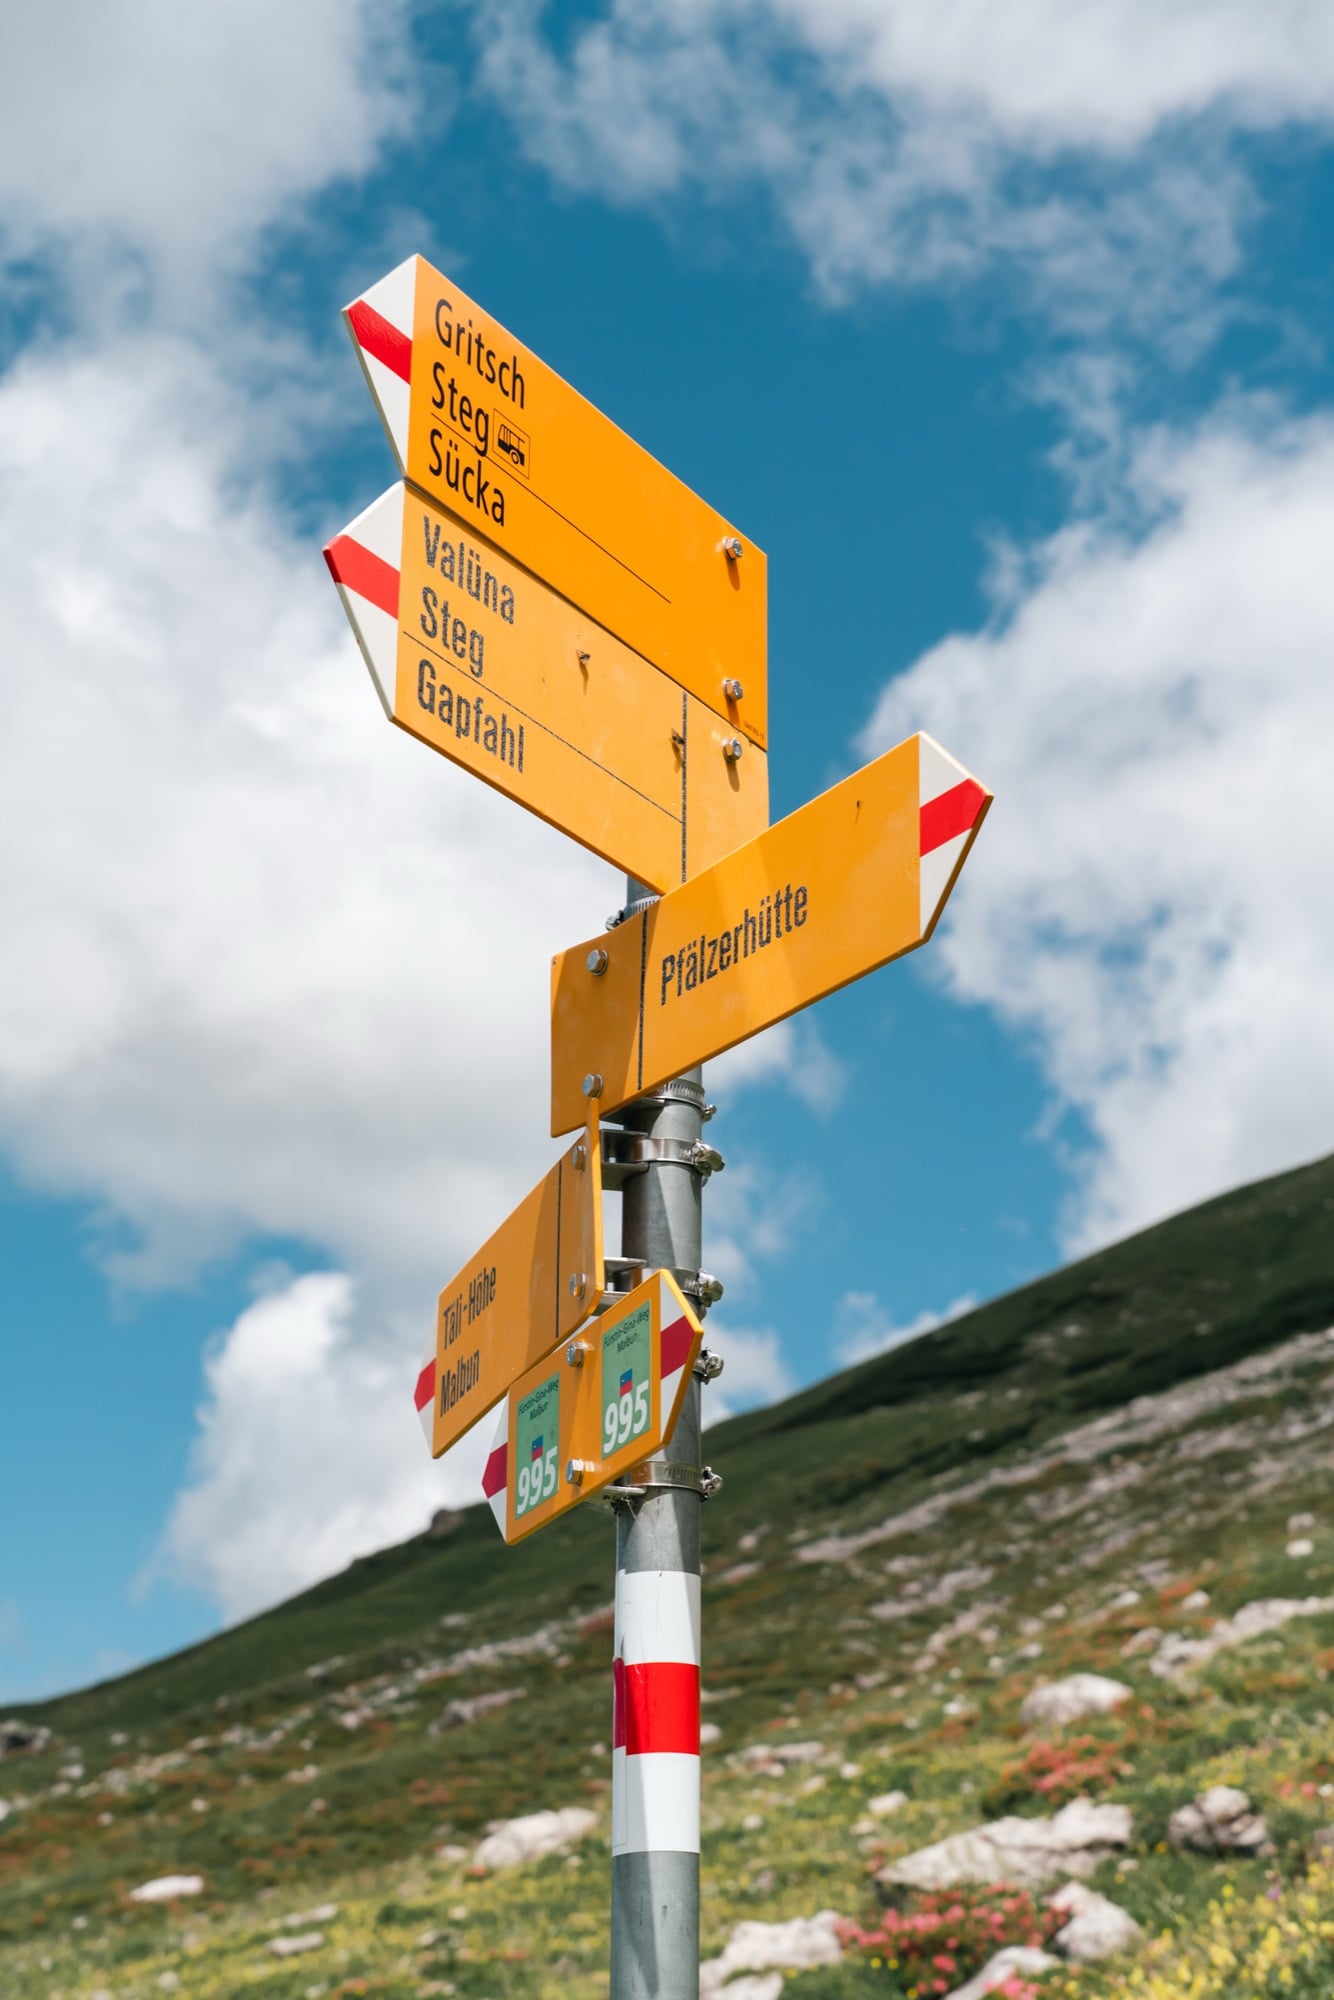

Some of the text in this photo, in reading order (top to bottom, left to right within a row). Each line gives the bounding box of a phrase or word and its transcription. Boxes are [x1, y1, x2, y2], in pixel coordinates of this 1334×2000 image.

[435, 299, 524, 410] Gritsch
[432, 362, 489, 457] Steg
[429, 428, 505, 527] Sücka
[424, 515, 515, 625] Valüna
[420, 586, 485, 678] Steg
[417, 659, 525, 774] Gapfahl
[661, 884, 808, 1007] Pfälzerhütte
[440, 1349, 480, 1418] Malbun
[603, 1380, 649, 1454] 995
[516, 1445, 558, 1515] 995
